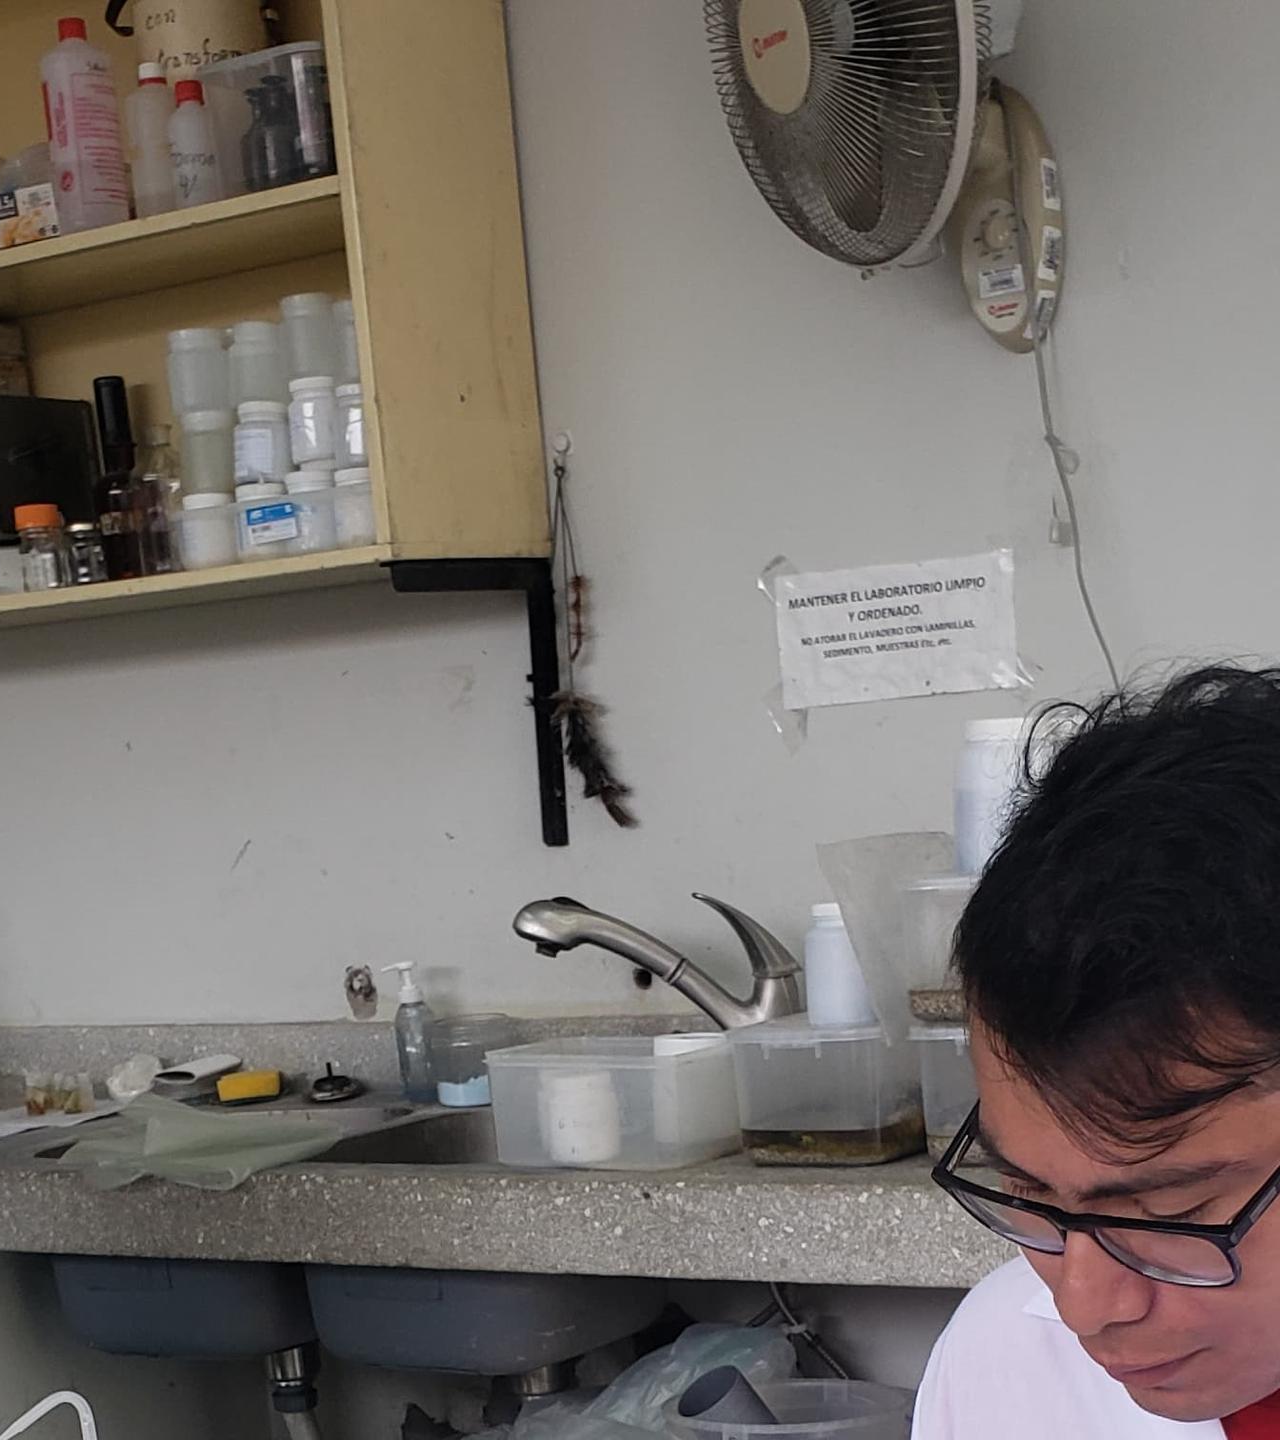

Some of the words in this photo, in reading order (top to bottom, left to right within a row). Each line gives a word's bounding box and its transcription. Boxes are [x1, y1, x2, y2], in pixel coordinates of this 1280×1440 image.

[788, 593, 848, 609] MANTENER
[851, 590, 863, 602] EL
[864, 581, 942, 601] LABORATORIO
[945, 577, 985, 592] LIMPIO
[848, 611, 855, 622] Y
[858, 604, 922, 621] ORDENADO.
[859, 627, 903, 640] LAVADERO
